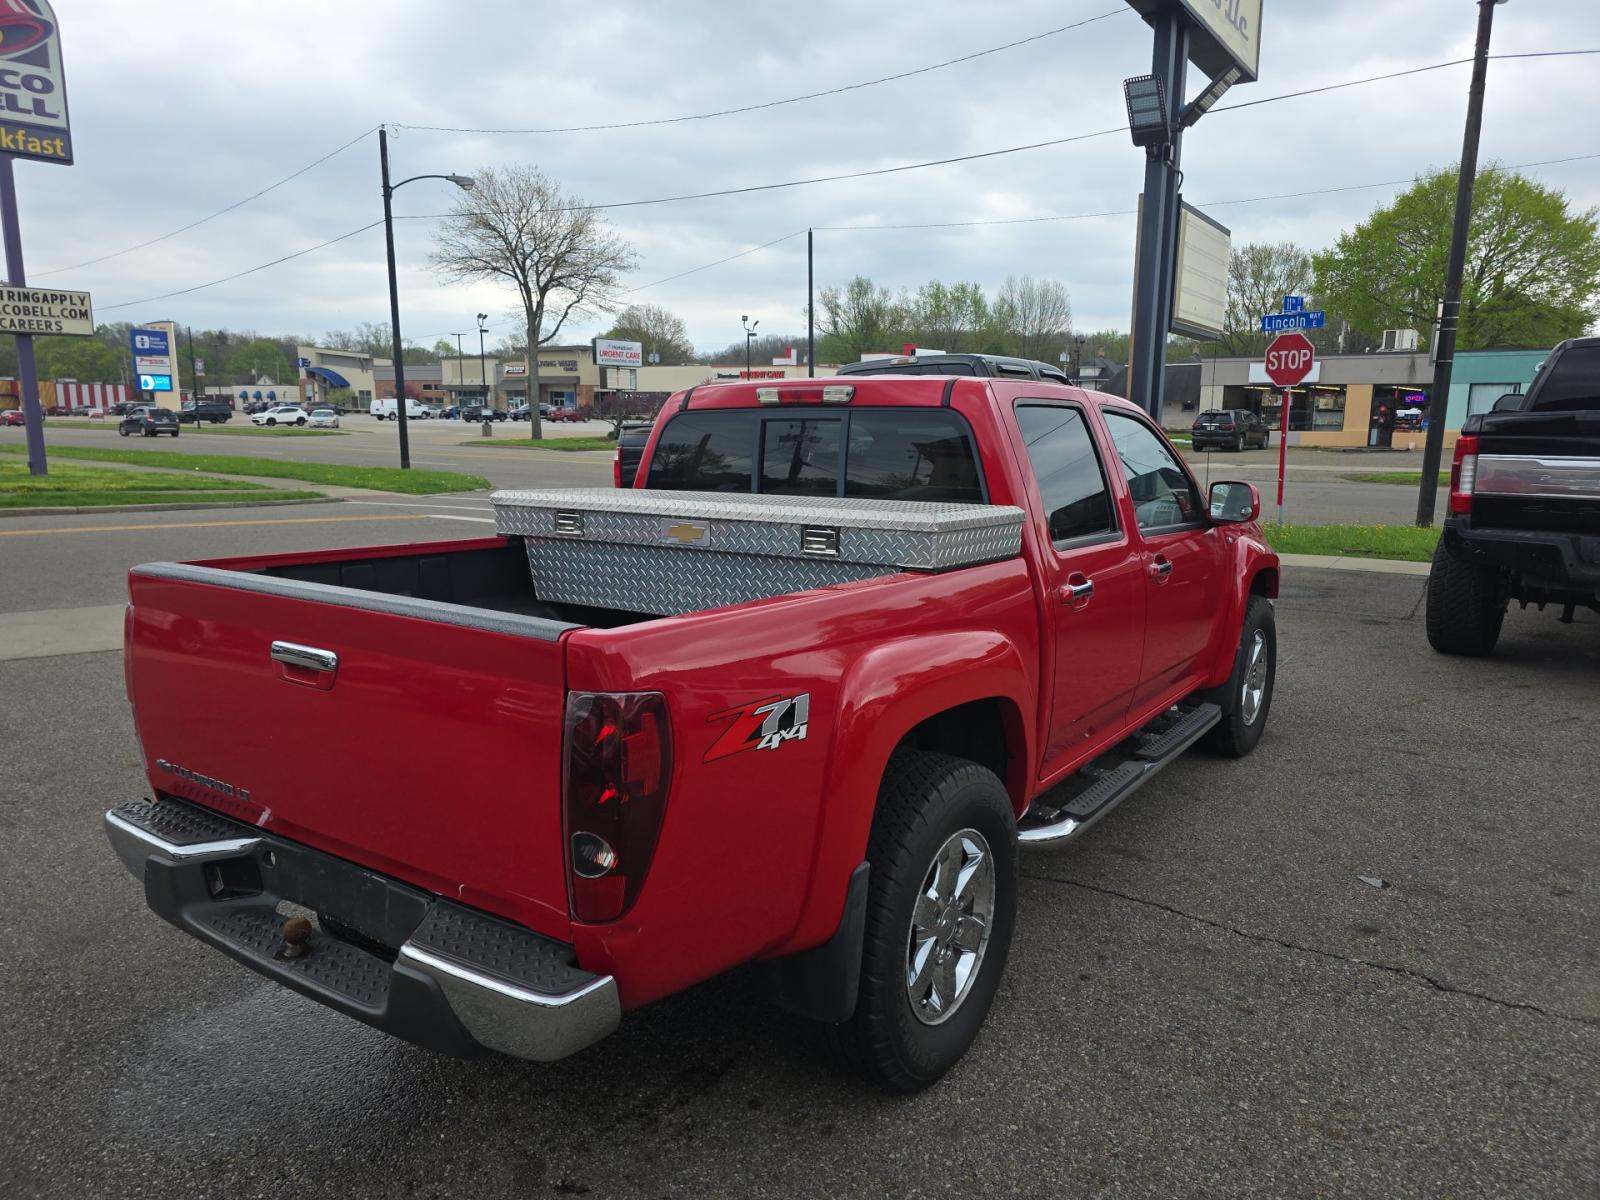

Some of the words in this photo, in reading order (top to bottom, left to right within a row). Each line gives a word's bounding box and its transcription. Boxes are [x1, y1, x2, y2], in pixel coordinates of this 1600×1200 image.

[1265, 316, 1306, 330] Lincoln
[625, 351, 641, 360] CARE
[1268, 349, 1311, 370] STOP
